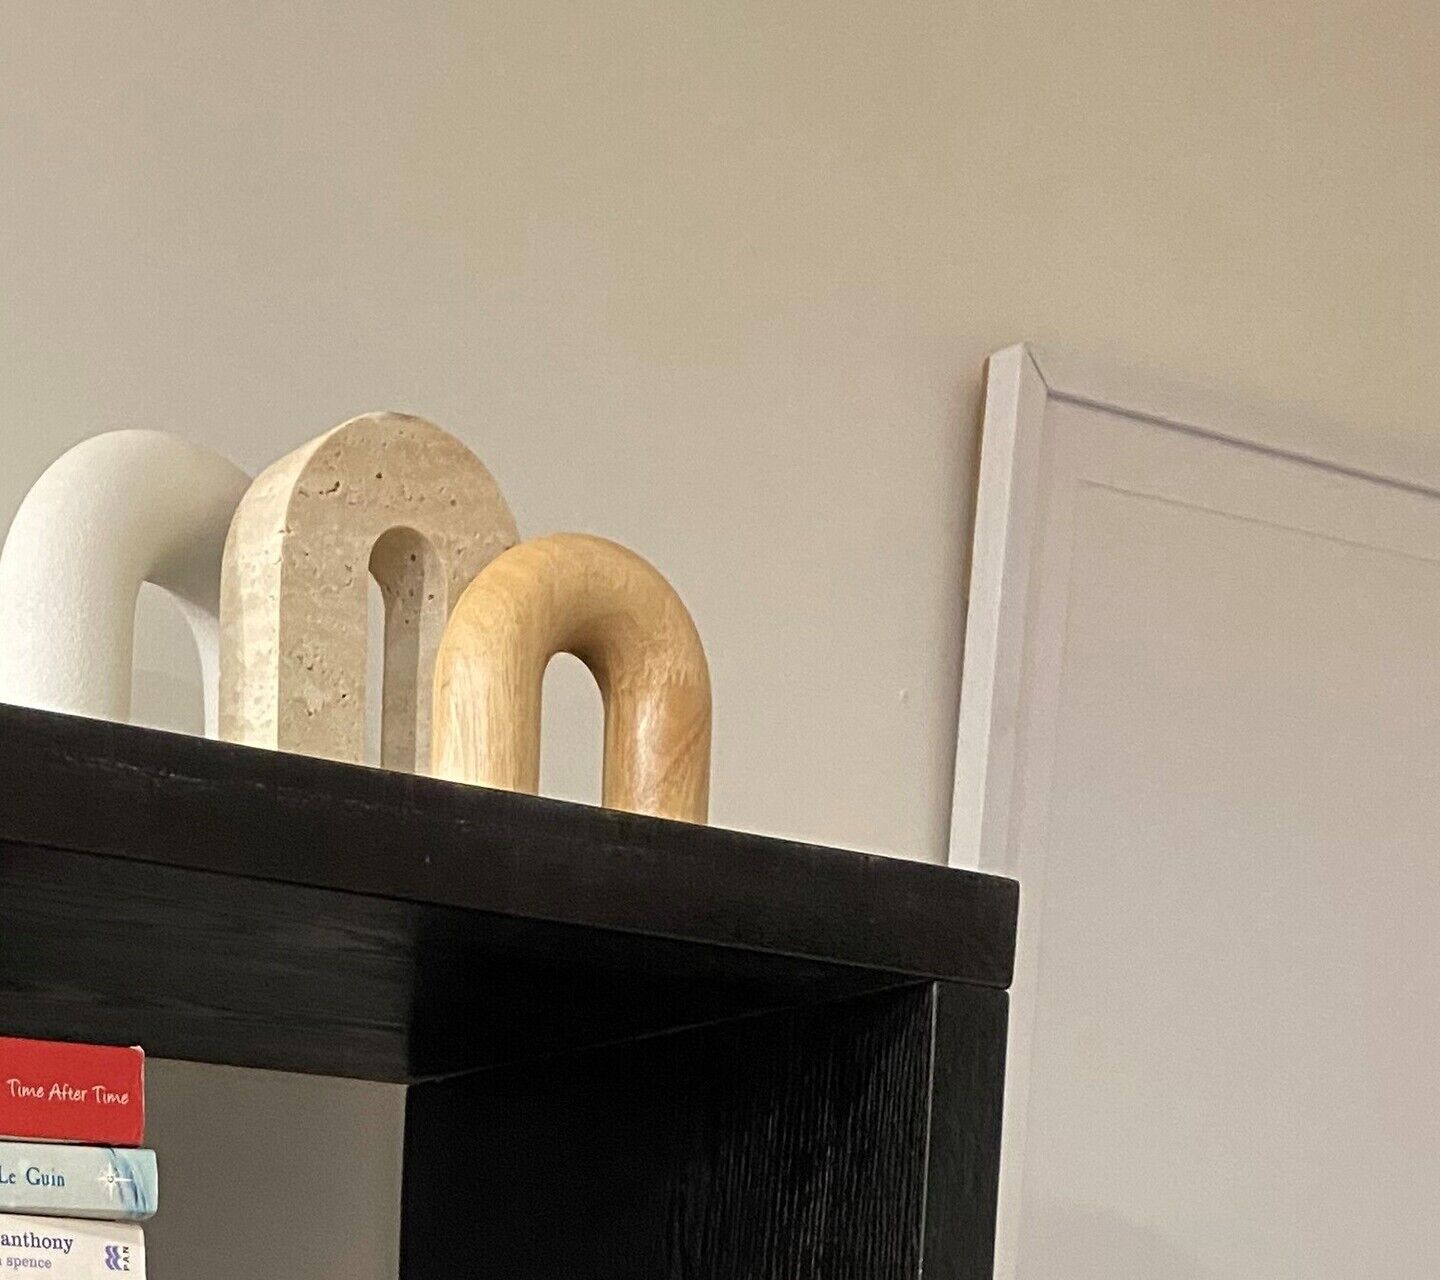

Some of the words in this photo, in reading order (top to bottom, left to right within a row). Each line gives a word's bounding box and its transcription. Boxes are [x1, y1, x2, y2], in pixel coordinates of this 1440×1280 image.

[6, 1078, 45, 1100] Time
[48, 1082, 88, 1104] After
[91, 1085, 129, 1106] Time
[25, 1166, 66, 1188] Guin
[0, 1230, 73, 1254] anthony
[6, 1255, 52, 1272] spence
[122, 1246, 130, 1272] PAN
